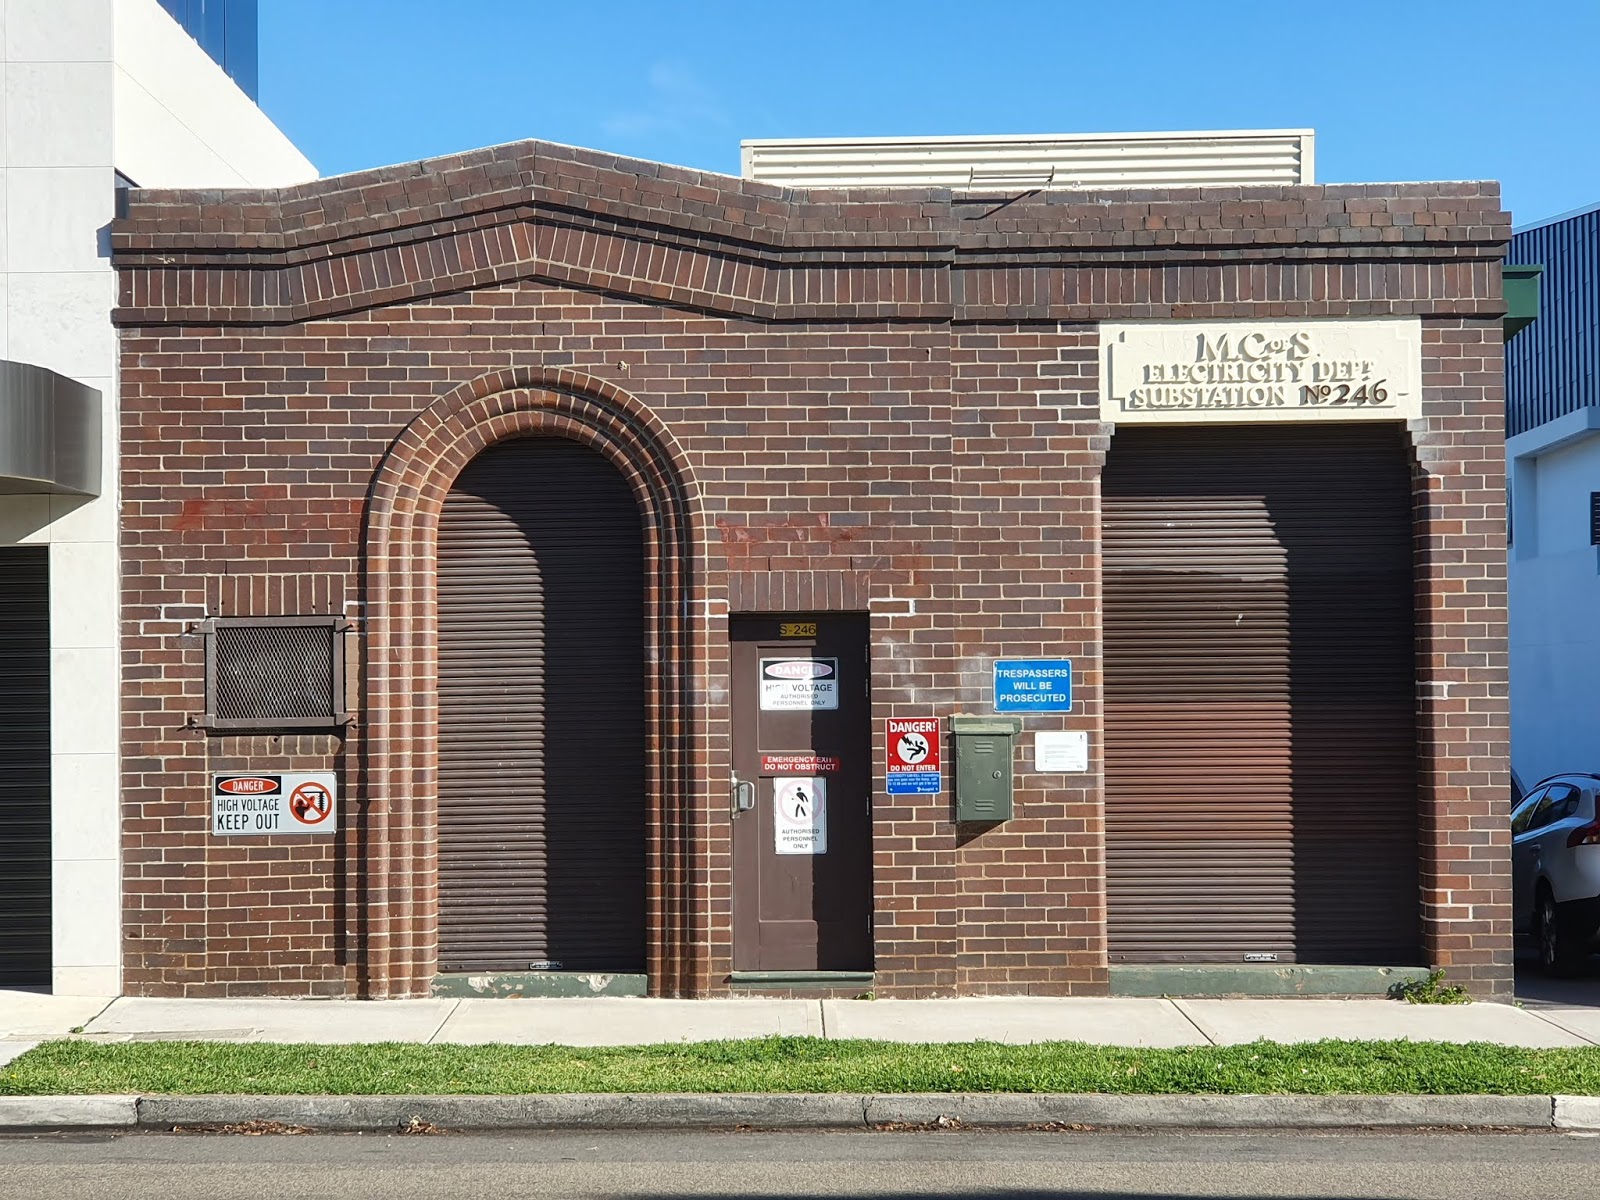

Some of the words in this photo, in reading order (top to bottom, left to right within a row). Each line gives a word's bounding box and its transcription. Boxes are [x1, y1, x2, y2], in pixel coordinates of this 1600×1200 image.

[1143, 361, 1303, 384] ELECTRICITY
[1129, 385, 1284, 409] SUBSTATION
[780, 624, 817, 635] S-246
[997, 669, 1068, 678] TRESPASSERS
[792, 684, 833, 692] VOLTAGE
[1013, 681, 1037, 690] WILL
[1039, 681, 1052, 690] BE
[1000, 694, 1066, 702] PROSECUTED
[889, 721, 936, 733] DANGER!
[232, 781, 264, 792] DANGER
[217, 799, 238, 812] HIGH
[241, 798, 280, 811] VOLTAGE
[217, 814, 249, 830] KEEP
[256, 814, 280, 829] OUT
